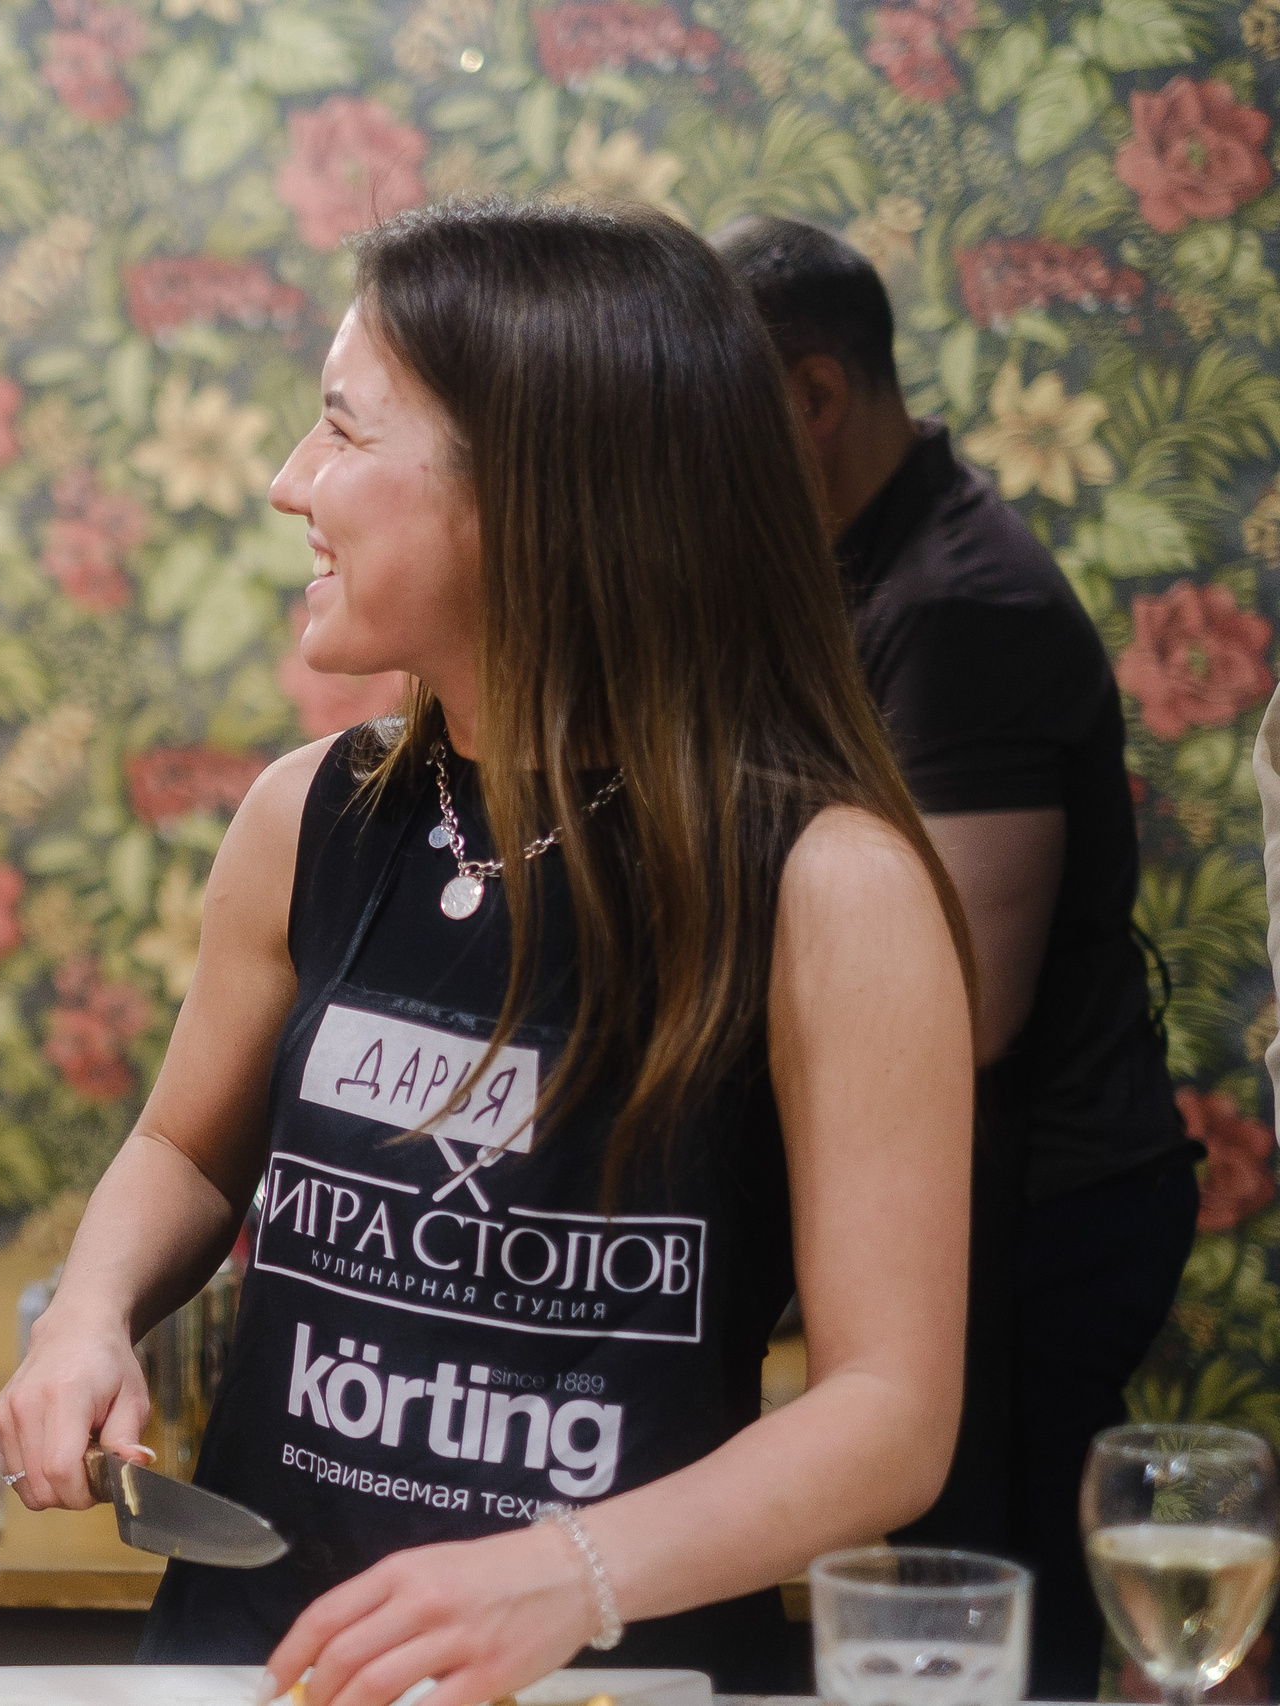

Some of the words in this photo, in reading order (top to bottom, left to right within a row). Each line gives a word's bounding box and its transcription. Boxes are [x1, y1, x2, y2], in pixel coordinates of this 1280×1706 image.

[335, 1038, 518, 1128] ДАРЬЯ
[268, 1168, 397, 1261] ИГРА
[412, 1209, 692, 1296] СТОЛОВ
[311, 1248, 477, 1304] КУЛИНАРНАЯ
[493, 1290, 608, 1320] СТУДИЯ
[288, 1321, 622, 1499] körting
[490, 1367, 545, 1389] since
[555, 1371, 606, 1395] 1889
[281, 1442, 470, 1512] встраиваемая
